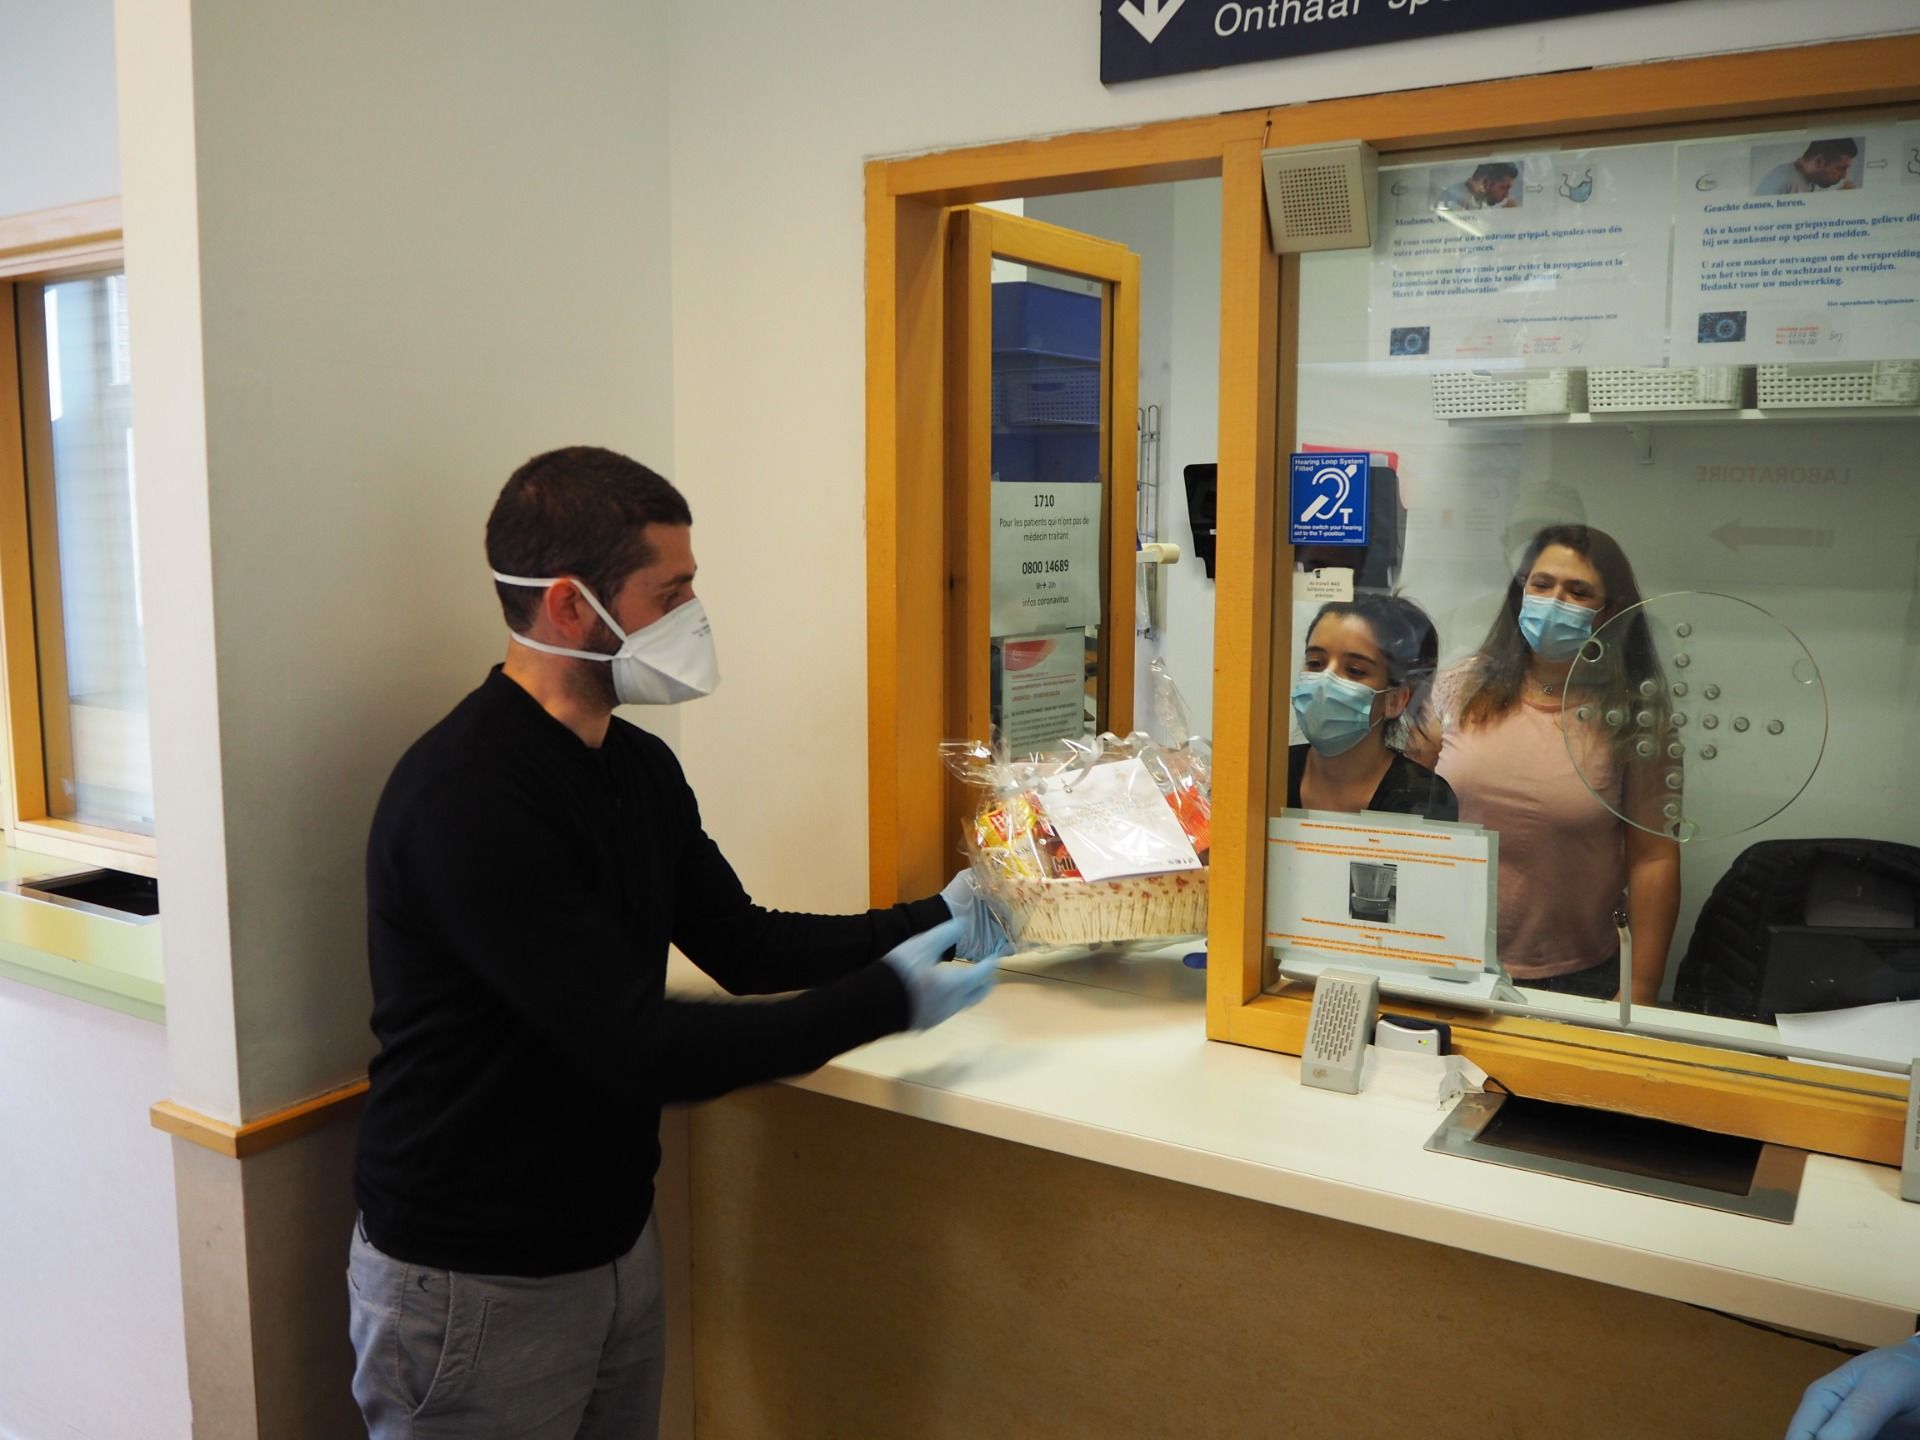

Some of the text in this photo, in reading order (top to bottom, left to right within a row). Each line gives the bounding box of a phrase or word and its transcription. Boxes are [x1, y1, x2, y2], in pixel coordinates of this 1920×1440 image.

[1704, 203, 1740, 213] Geachte
[1703, 227, 1717, 235] Als
[1728, 225, 1751, 233] komt
[1753, 223, 1773, 231] voor
[1794, 216, 1868, 231] griepsyndroom,
[1871, 215, 1904, 226] gelieve
[1518, 229, 1550, 241] grippal,
[1702, 237, 1714, 247] bij
[1732, 234, 1776, 244] aankomst
[1778, 234, 1790, 243] op
[1793, 231, 1819, 242] spoed
[1822, 231, 1831, 239] te
[1834, 228, 1870, 238] melden.
[1552, 259, 1604, 271] propagation
[1605, 259, 1613, 267] et
[1615, 257, 1623, 265] la
[1711, 260, 1724, 269] zal
[1744, 257, 1776, 266] masker
[1779, 254, 1827, 265] ontvangen
[1847, 251, 1858, 260] de
[1719, 270, 1734, 279] het
[1736, 269, 1758, 278] virus
[1760, 268, 1769, 276] in
[1771, 267, 1783, 276] de
[1785, 265, 1831, 275] wachtzaal
[1834, 265, 1843, 273] te
[1845, 262, 1896, 273] vermijden.
[1700, 281, 1737, 291] Bedankt
[1739, 281, 1759, 289] voor
[1762, 280, 1775, 288] uw
[1295, 458, 1363, 466] Hearing Loop System
[1034, 494, 1055, 508] 1710
[1000, 515, 1090, 529] Pour les patients qui n'ont pas de
[1339, 508, 1353, 524] T
[1342, 524, 1362, 532] hearing
[1023, 531, 1069, 542] médecin traitant
[1022, 559, 1069, 574] 0800 14689
[1022, 595, 1069, 608] infos coronavirus
